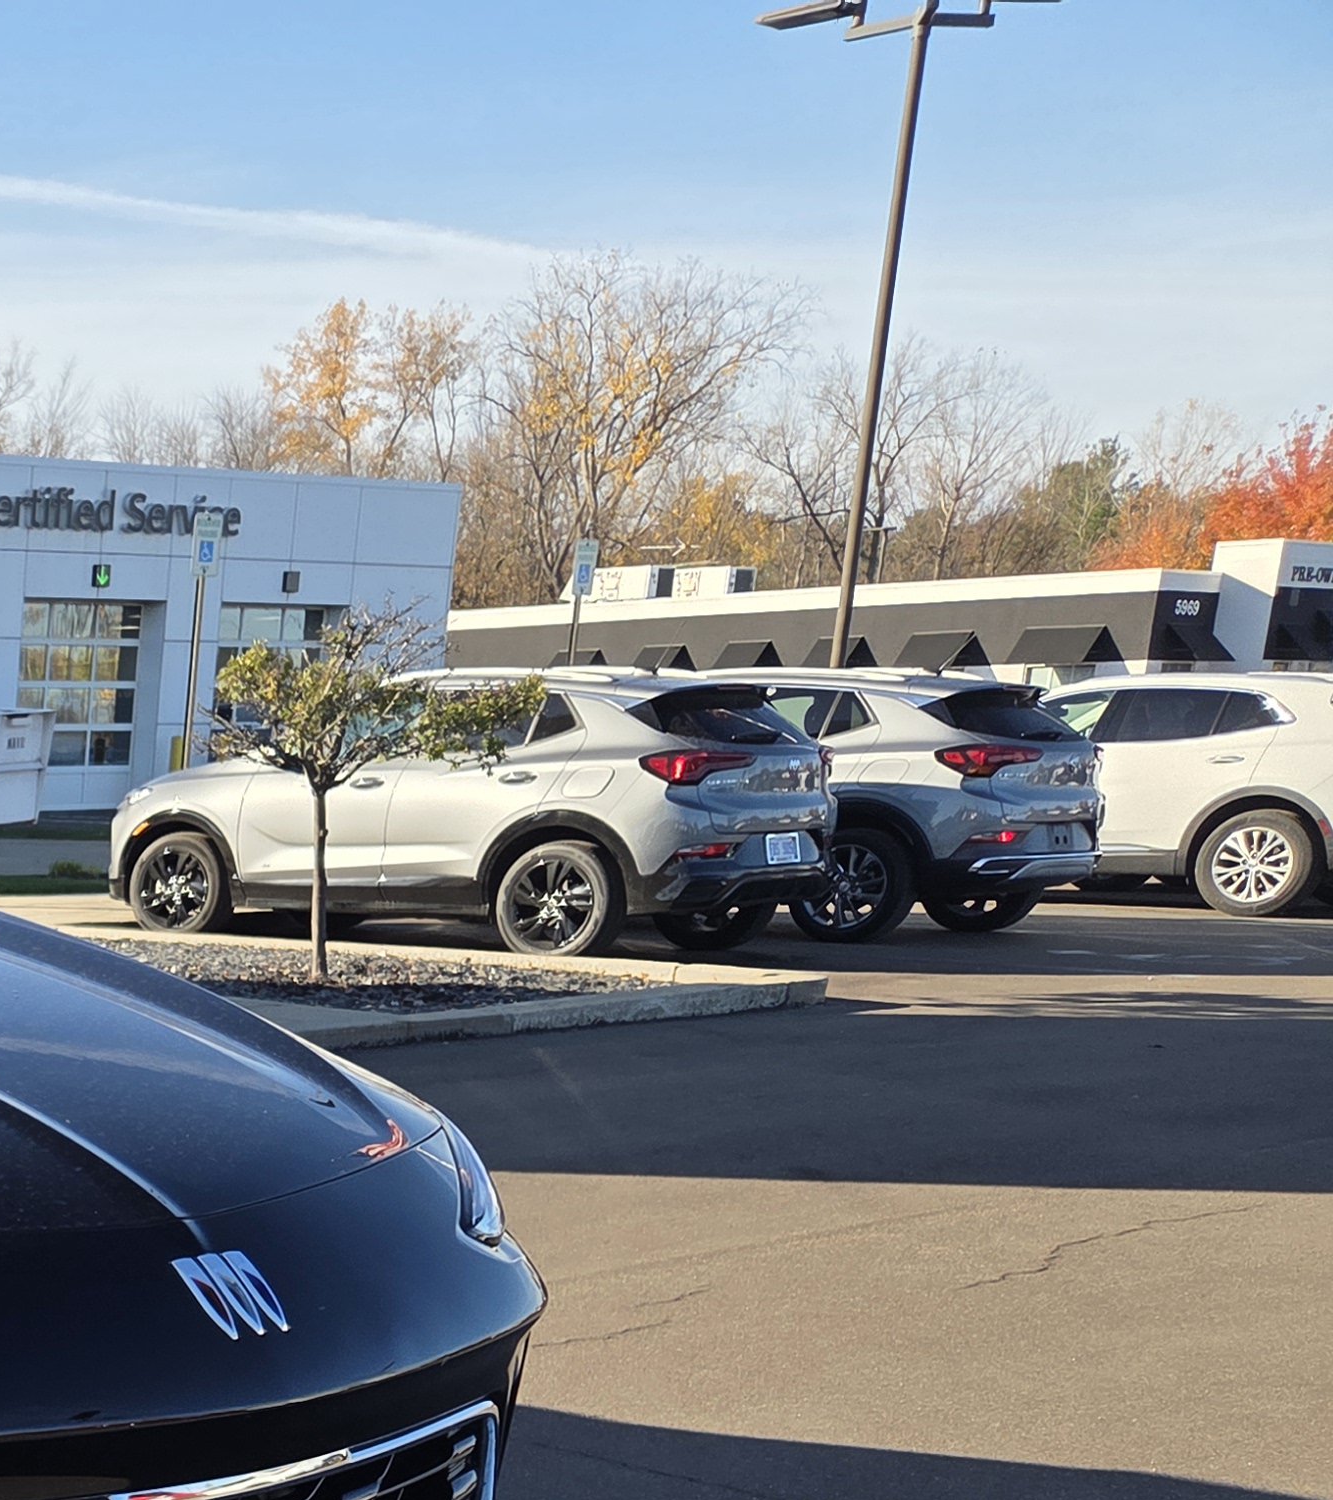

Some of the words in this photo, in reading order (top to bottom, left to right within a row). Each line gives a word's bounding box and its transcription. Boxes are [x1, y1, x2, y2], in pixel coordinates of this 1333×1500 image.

[122, 492, 241, 538] Serve
[1290, 565, 1333, 583] PRE-OW
[1174, 599, 1200, 616] 5969
